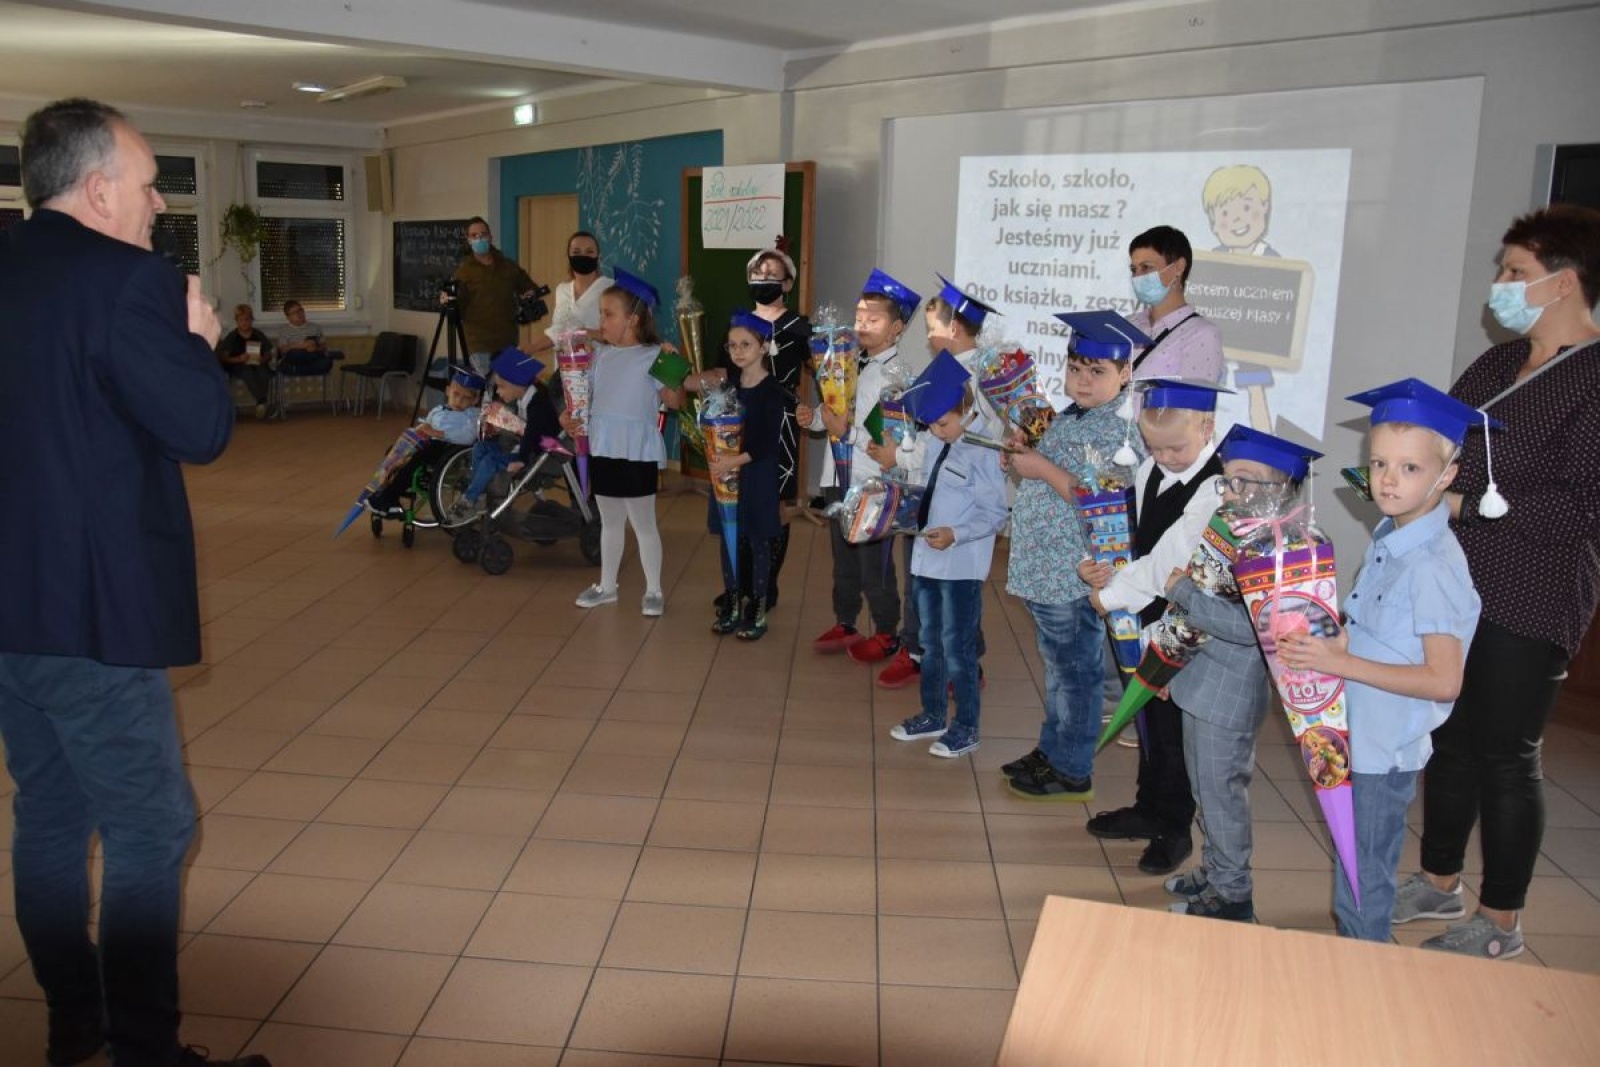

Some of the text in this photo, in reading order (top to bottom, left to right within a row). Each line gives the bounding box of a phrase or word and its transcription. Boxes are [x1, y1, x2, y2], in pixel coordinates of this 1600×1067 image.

[987, 167, 1136, 191] Szkoło, szkoło,
[991, 198, 1128, 222] jak się masz ?
[995, 227, 1121, 254] Jesteśmy już
[1008, 258, 1101, 280] uczniami.
[965, 282, 1146, 317] Oto książka, zeszy
[1233, 286, 1294, 301] uczniem
